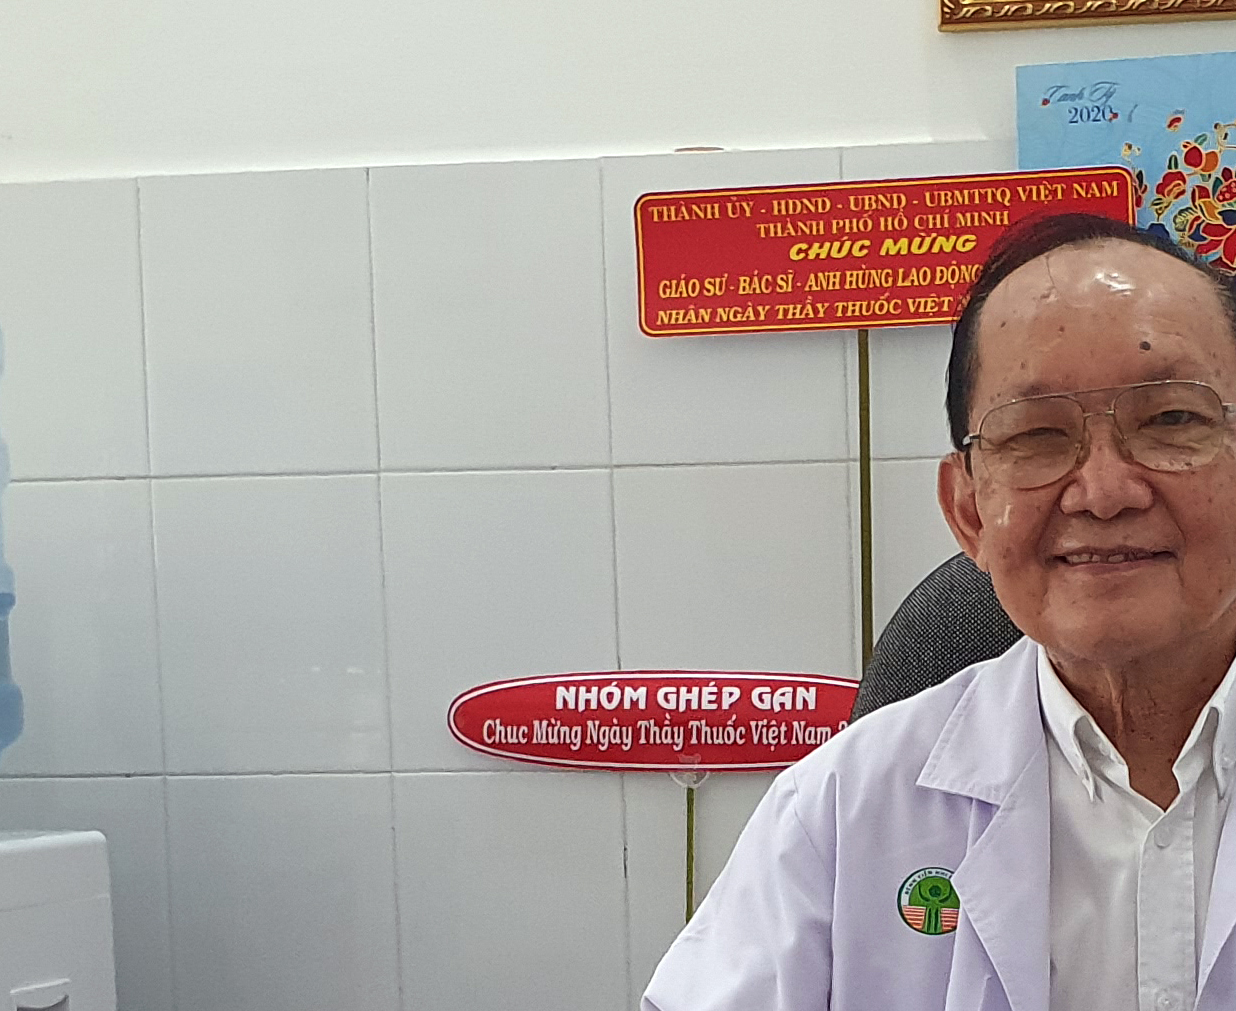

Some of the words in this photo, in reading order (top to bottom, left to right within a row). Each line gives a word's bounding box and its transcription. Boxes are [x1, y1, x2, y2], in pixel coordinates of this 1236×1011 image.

[649, 201, 720, 222] THÀNH
[1016, 181, 1066, 204] VIỆT
[1073, 180, 1118, 199] NAM
[756, 218, 825, 238] THÀNH
[914, 209, 949, 229] CHÍ
[956, 210, 1009, 228] MINH
[789, 236, 871, 261] CHÚC
[879, 232, 977, 256] MỪNG
[658, 273, 700, 299] GIÁO
[738, 269, 772, 295] BÁC
[804, 271, 842, 292] ANH
[844, 264, 894, 289] HÙNG
[896, 266, 932, 287] LAO
[656, 305, 713, 326] NHÂN
[715, 301, 771, 323] NGÀY
[555, 681, 647, 712] NHÓM
[656, 681, 741, 713] GHÉP
[751, 686, 817, 713] GAN
[532, 718, 582, 751] Mừng
[586, 718, 632, 751] Ngày
[791, 721, 832, 745] Nam
